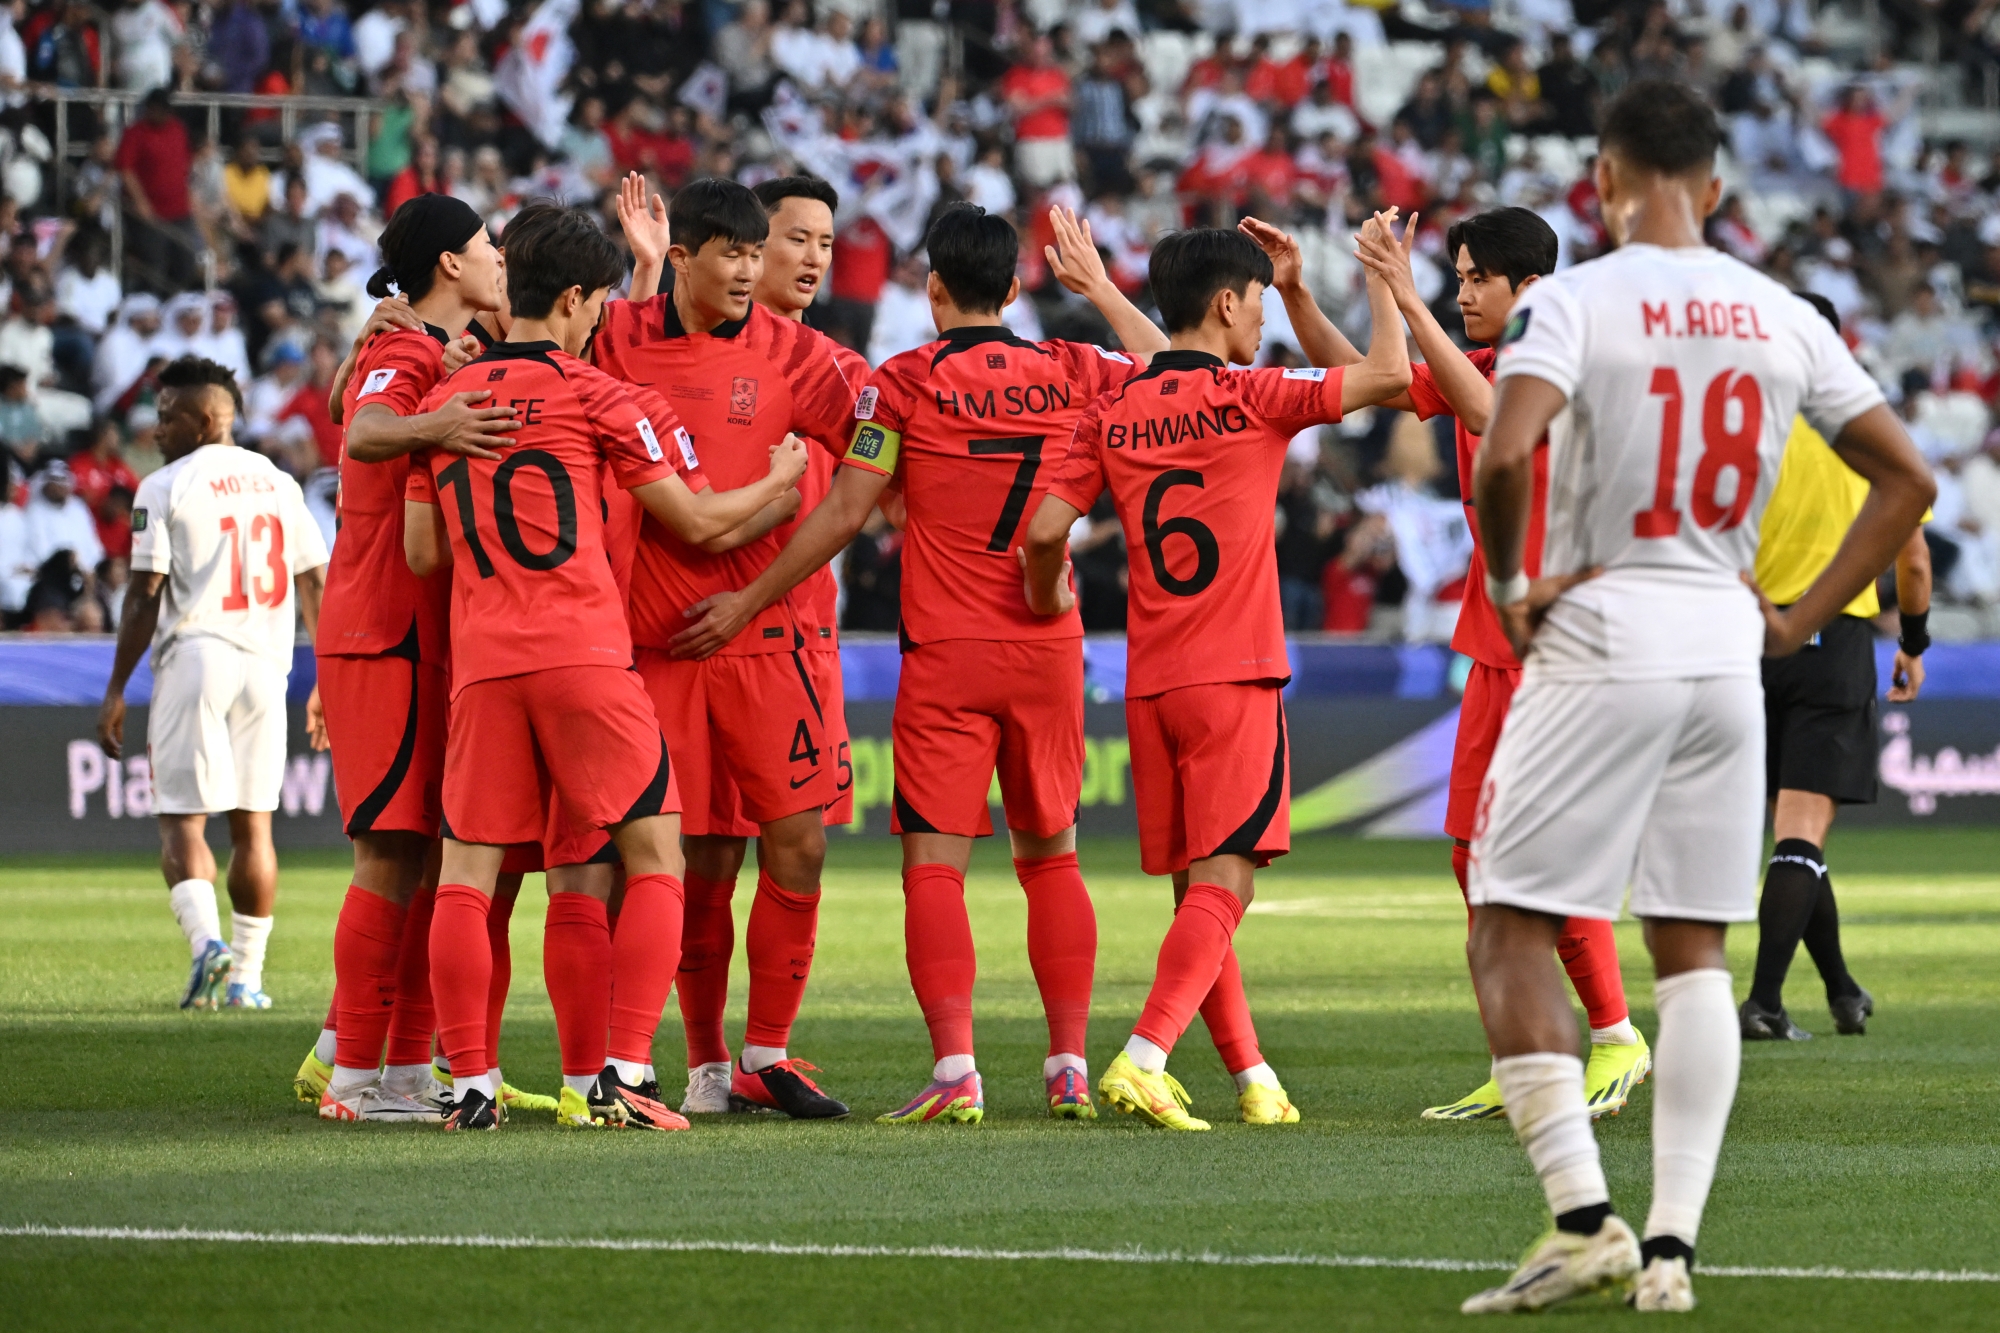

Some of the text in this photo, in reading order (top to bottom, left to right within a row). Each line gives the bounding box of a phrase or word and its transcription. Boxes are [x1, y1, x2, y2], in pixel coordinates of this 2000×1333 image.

[1641, 300, 1771, 341] M.ADEL
[726, 416, 752, 427] KOREA
[1003, 381, 1071, 417] SON
[862, 429, 874, 437] AFC
[1132, 405, 1247, 450] HWANG
[1634, 366, 1764, 540] 18
[209, 474, 275, 498] MOSES
[967, 435, 1048, 553] 7
[436, 448, 577, 580] 10
[1142, 468, 1220, 597] 6
[220, 513, 288, 613] 13
[788, 718, 820, 767] 4
